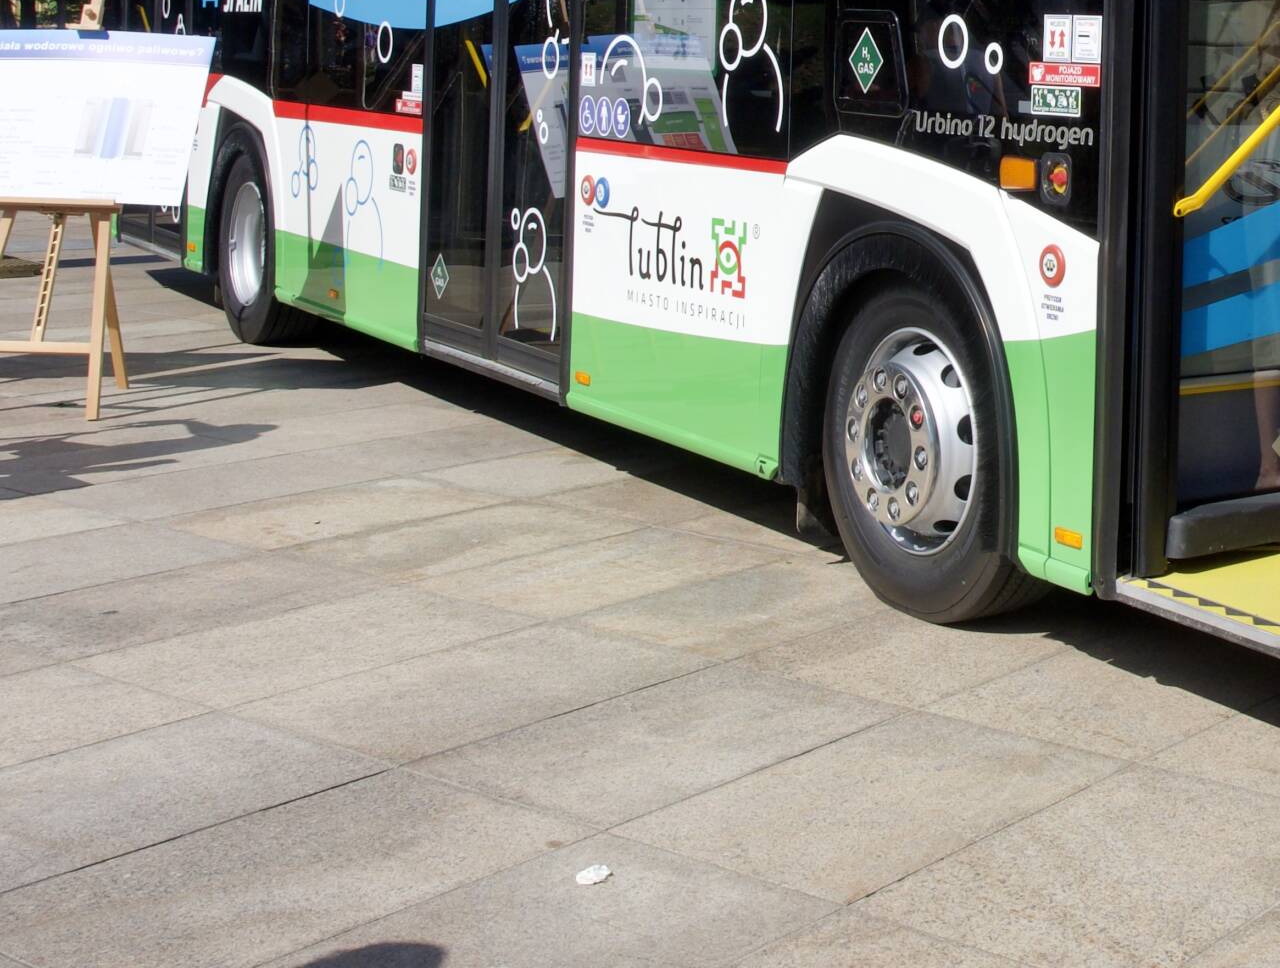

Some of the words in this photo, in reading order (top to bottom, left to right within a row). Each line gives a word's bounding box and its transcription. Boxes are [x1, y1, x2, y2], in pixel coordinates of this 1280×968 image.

[24, 40, 84, 51] wodorowe
[88, 42, 134, 53] ogniwo
[857, 63, 874, 74] GAS
[1058, 65, 1082, 75] POJAZD
[1045, 74, 1096, 84] MONITOROWANY
[914, 110, 973, 137] Urbino
[978, 115, 995, 137] 12
[1000, 117, 1094, 149] hydrogen
[627, 289, 669, 311] MIASTO
[676, 298, 746, 329] INSPIRACJI
